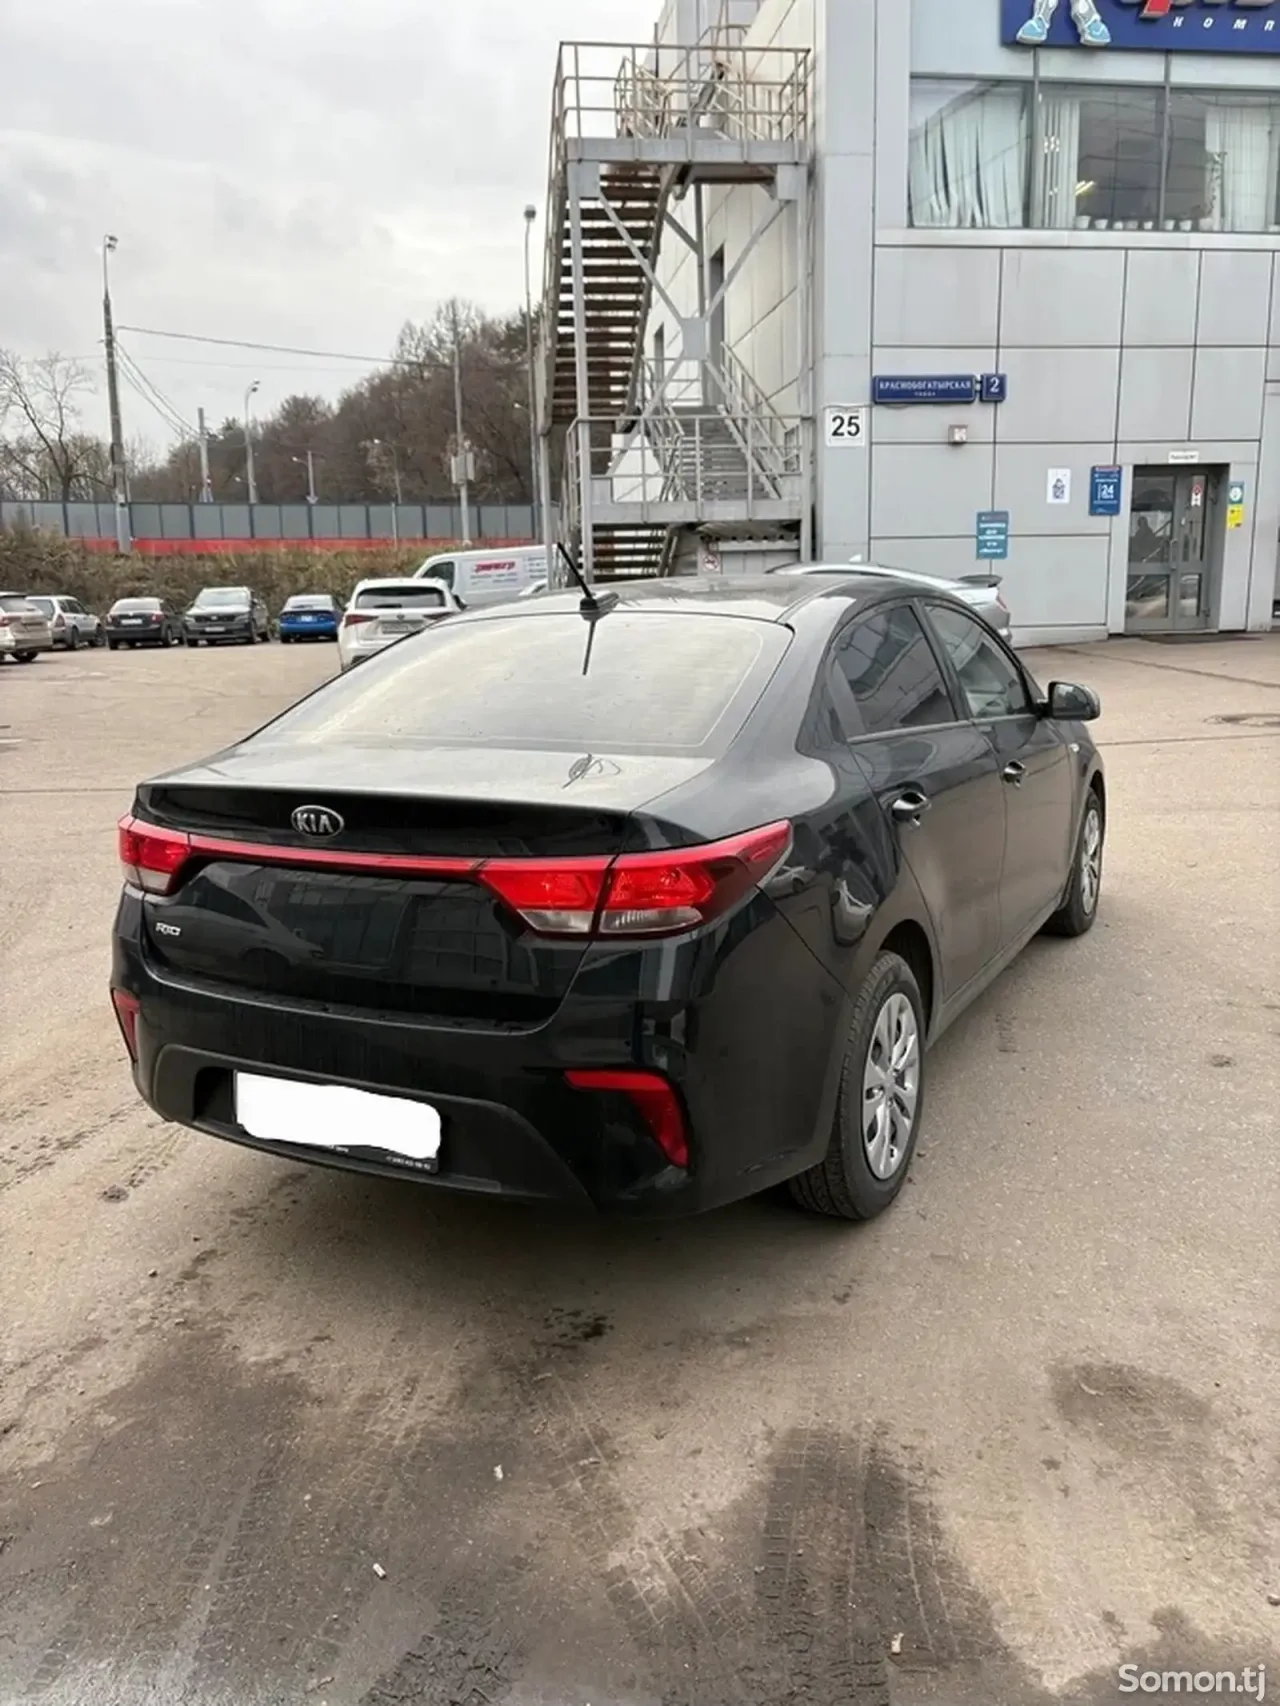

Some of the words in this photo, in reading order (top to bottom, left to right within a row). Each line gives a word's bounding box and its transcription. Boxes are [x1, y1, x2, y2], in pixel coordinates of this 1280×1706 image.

[879, 380, 971, 391] КРАСНОБОГАТЫРСКАЯ
[990, 377, 1000, 393] 2
[831, 415, 861, 437] 25
[296, 812, 334, 833] KIA
[155, 921, 181, 936] RIO
